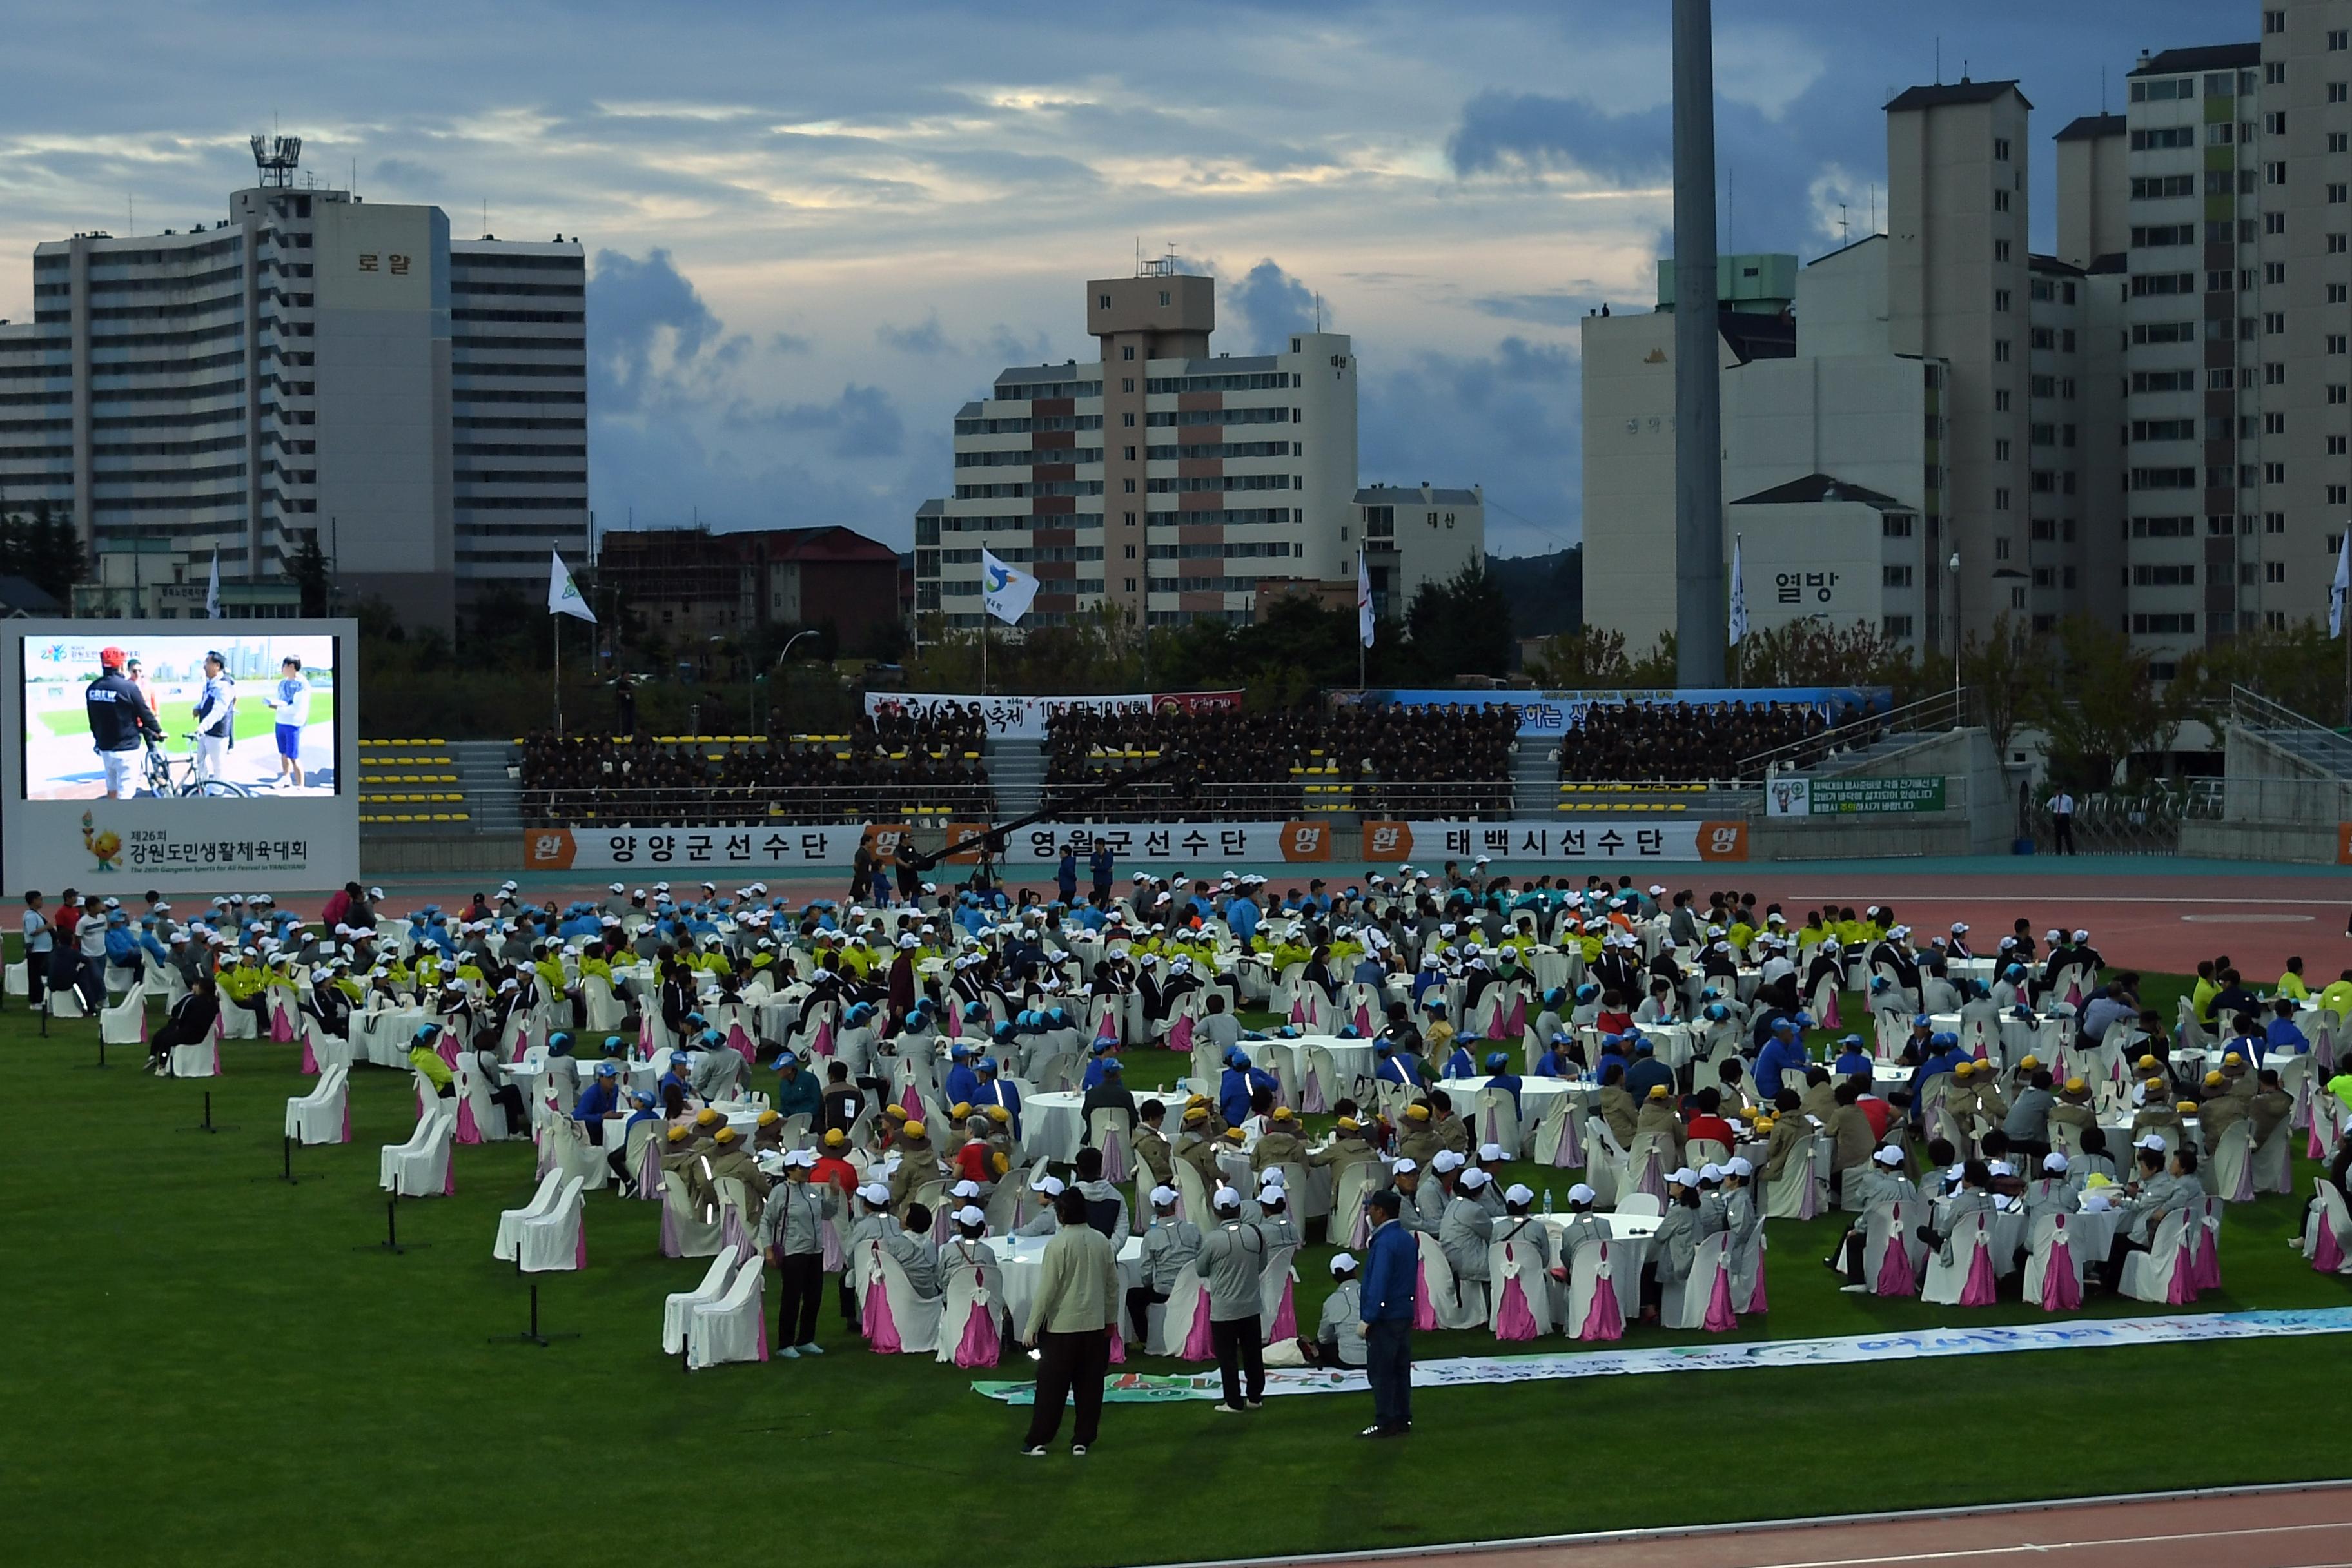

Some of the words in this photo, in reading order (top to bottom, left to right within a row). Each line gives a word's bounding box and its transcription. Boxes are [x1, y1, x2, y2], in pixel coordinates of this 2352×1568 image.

[358, 254, 411, 275] 로얄
[1427, 512, 1455, 529] 태산
[1776, 572, 1839, 603] 열방
[131, 830, 167, 842] 제26회
[534, 835, 562, 861] 환
[609, 832, 828, 863] 양양군선수단
[1030, 830, 1247, 858] 영월군선수단
[1295, 828, 1320, 853] 영
[1371, 827, 1400, 853] 환
[1446, 829, 1663, 857] 태백시선수단
[1710, 828, 1738, 852] 영
[130, 841, 307, 865] 강원도민생활체육대회
[161, 866, 193, 874] Gangwon
